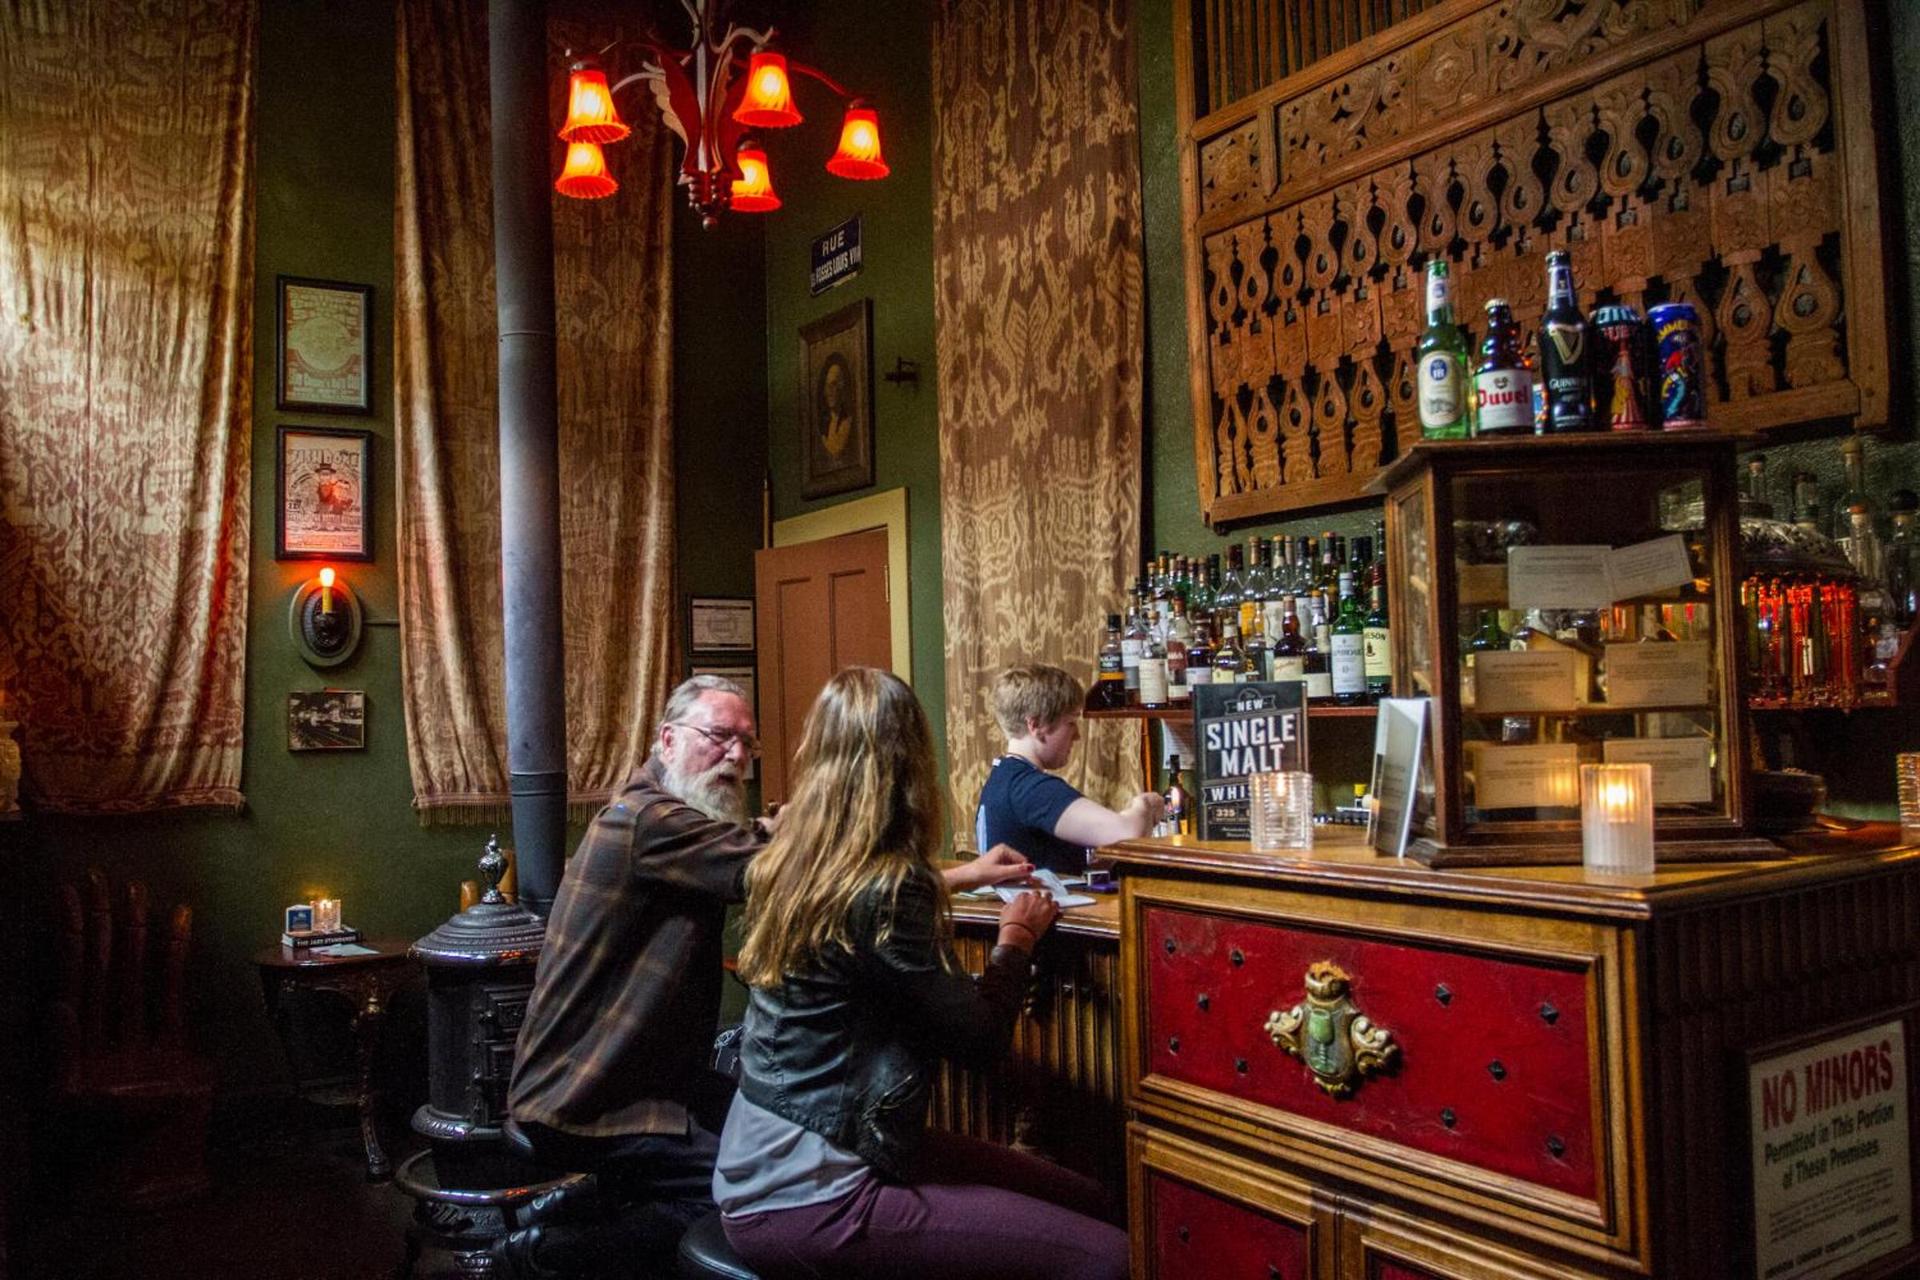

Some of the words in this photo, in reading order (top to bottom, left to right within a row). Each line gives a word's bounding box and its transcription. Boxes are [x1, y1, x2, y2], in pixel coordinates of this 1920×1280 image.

[822, 229, 845, 256] RUE
[1478, 385, 1528, 408] Duvel
[1236, 699, 1264, 712] NEW
[1207, 714, 1296, 751] SINGLE
[1221, 744, 1285, 777] MALT
[1761, 1069, 1797, 1131] NO
[1805, 1039, 1893, 1115] MINORS
[1765, 1126, 1816, 1166] Permitted
[1832, 1114, 1854, 1138] This
[1857, 1103, 1894, 1131] Portion
[1796, 1157, 1827, 1184] These
[1830, 1138, 1879, 1169] Premises
